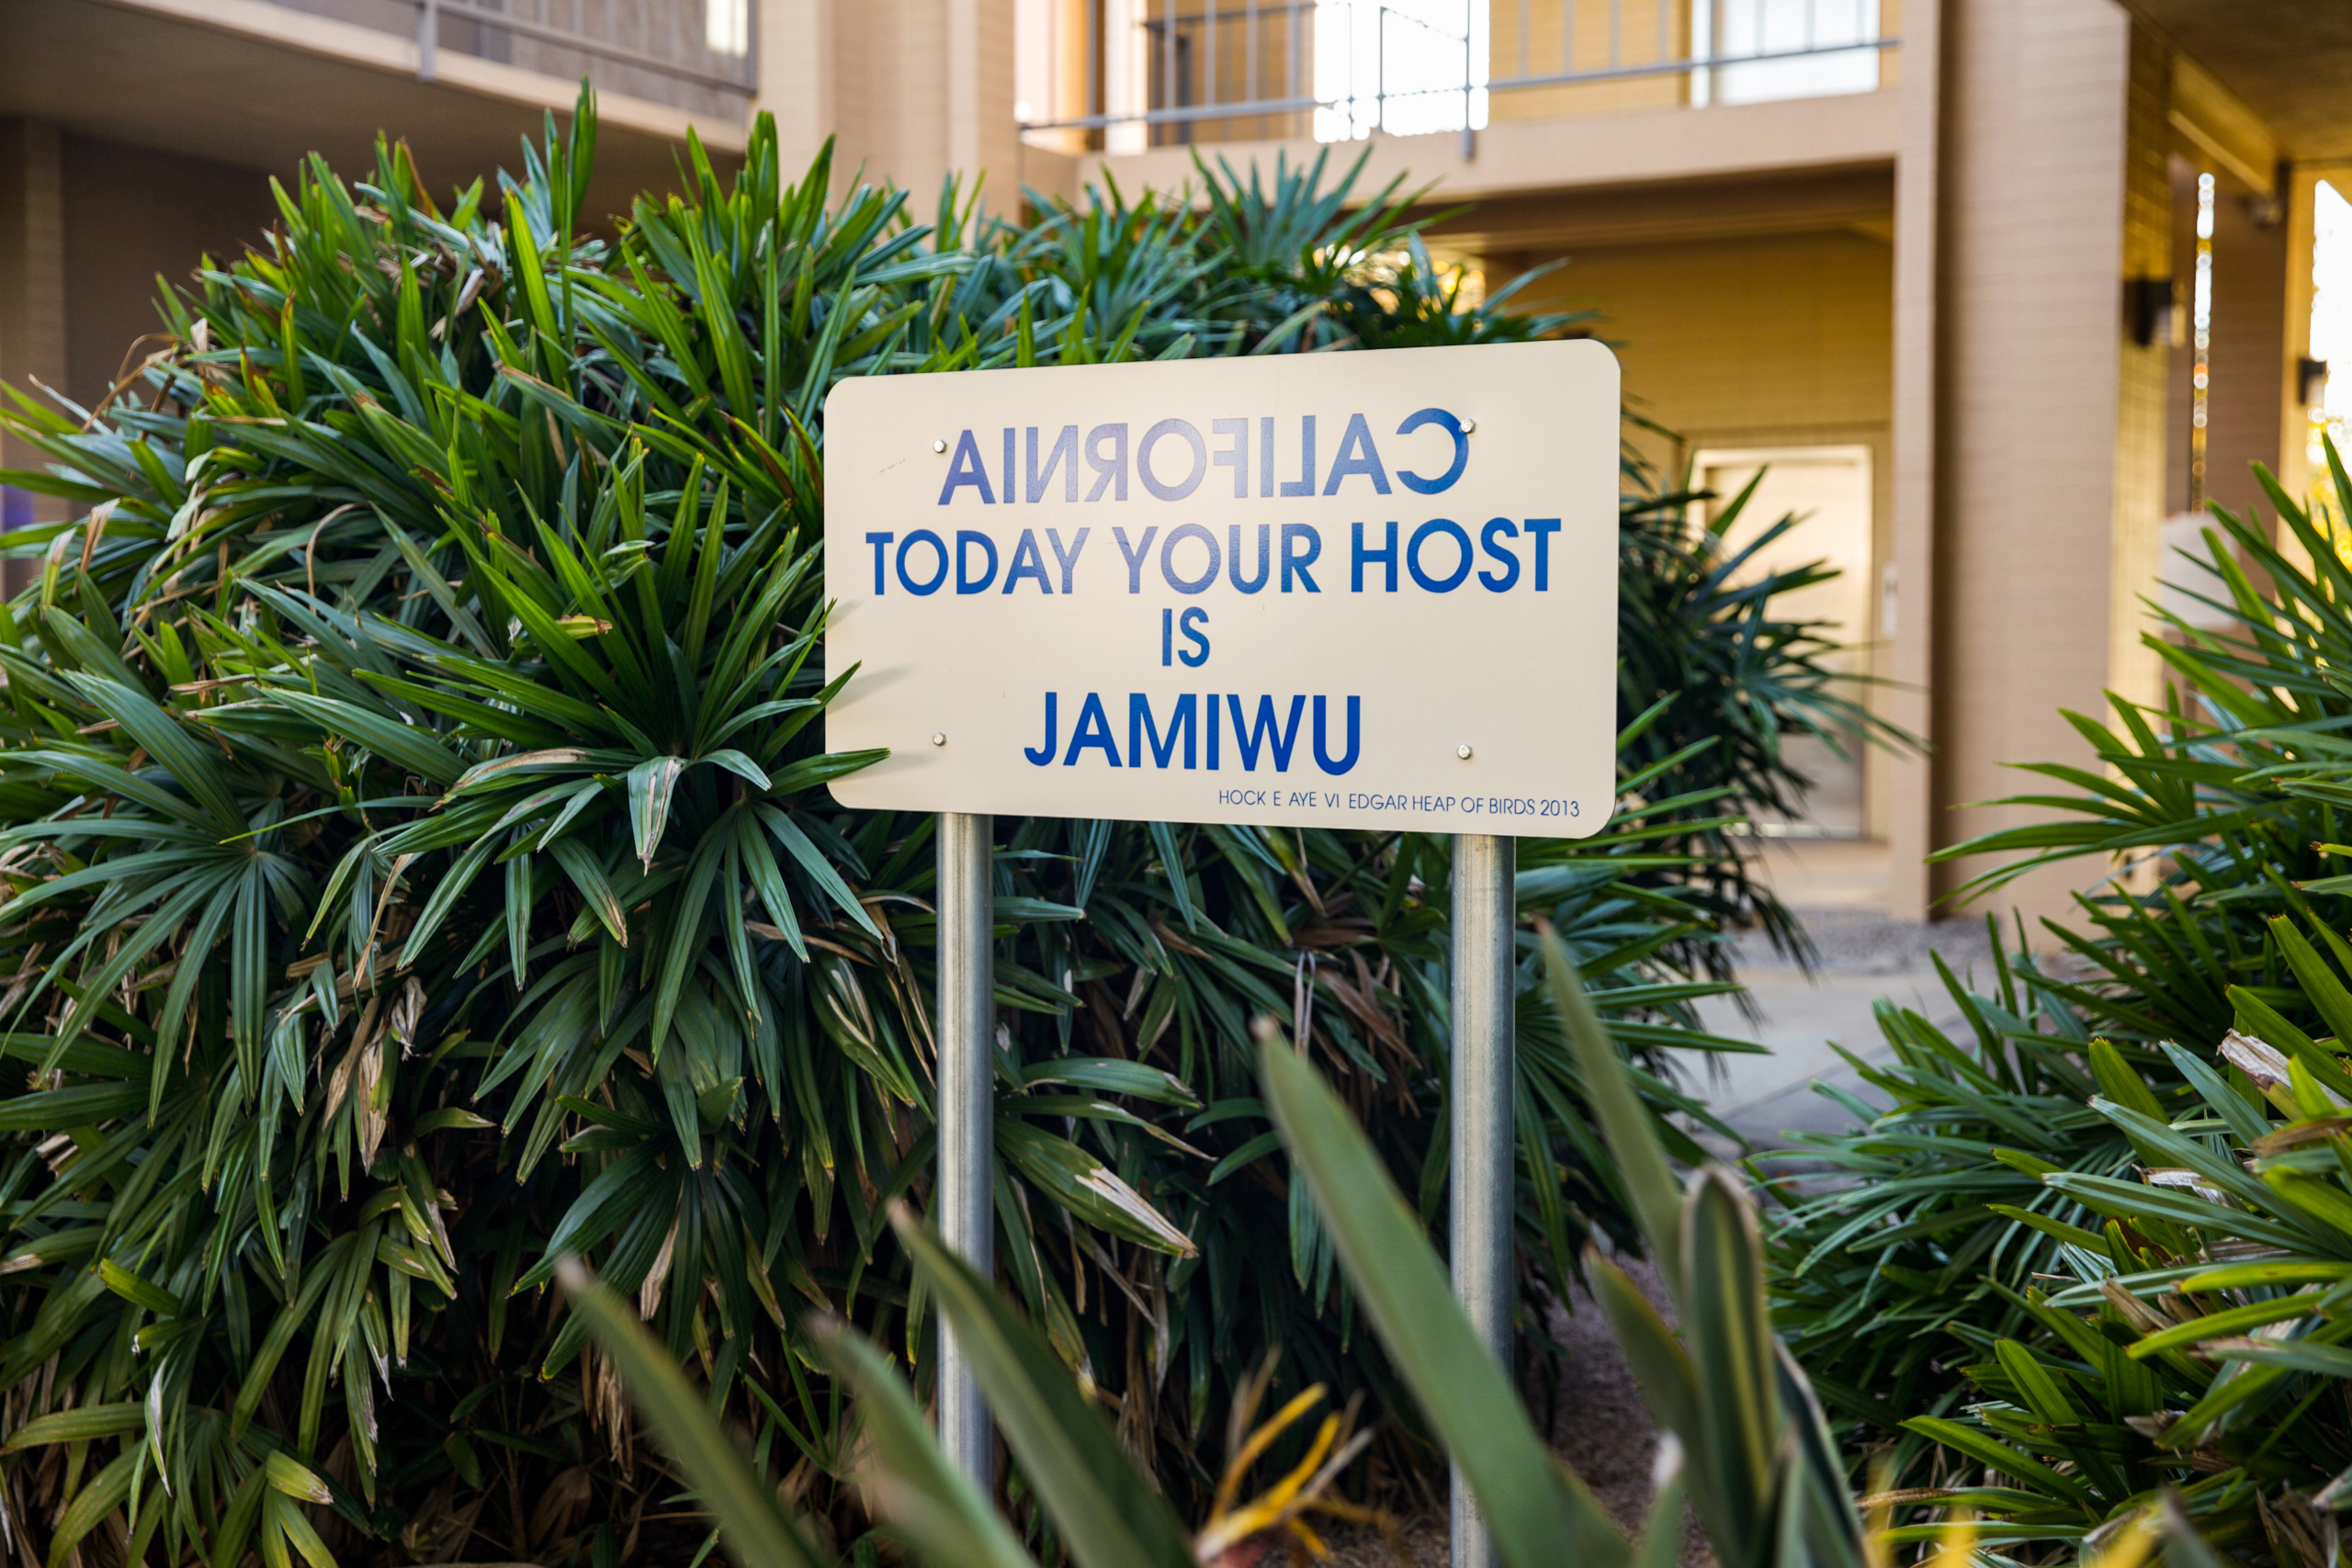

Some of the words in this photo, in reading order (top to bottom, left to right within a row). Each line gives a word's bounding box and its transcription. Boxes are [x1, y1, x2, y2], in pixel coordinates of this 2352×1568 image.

[865, 527, 1091, 597] TODAY
[1111, 523, 1322, 595] YOUR
[1351, 517, 1562, 594] HOST
[1161, 605, 1211, 669] IS
[1023, 691, 1362, 777] JAMIWU
[1218, 789, 1266, 807] HOCK
[1272, 790, 1282, 807] E
[1288, 791, 1317, 807] AYE
[1324, 793, 1340, 808] VI
[1348, 793, 1408, 811] EDGAR
[1411, 795, 1456, 812] HEAP
[1460, 796, 1485, 814] OF
[1488, 797, 1536, 816] BIRDS
[1540, 799, 1580, 818] 2013
